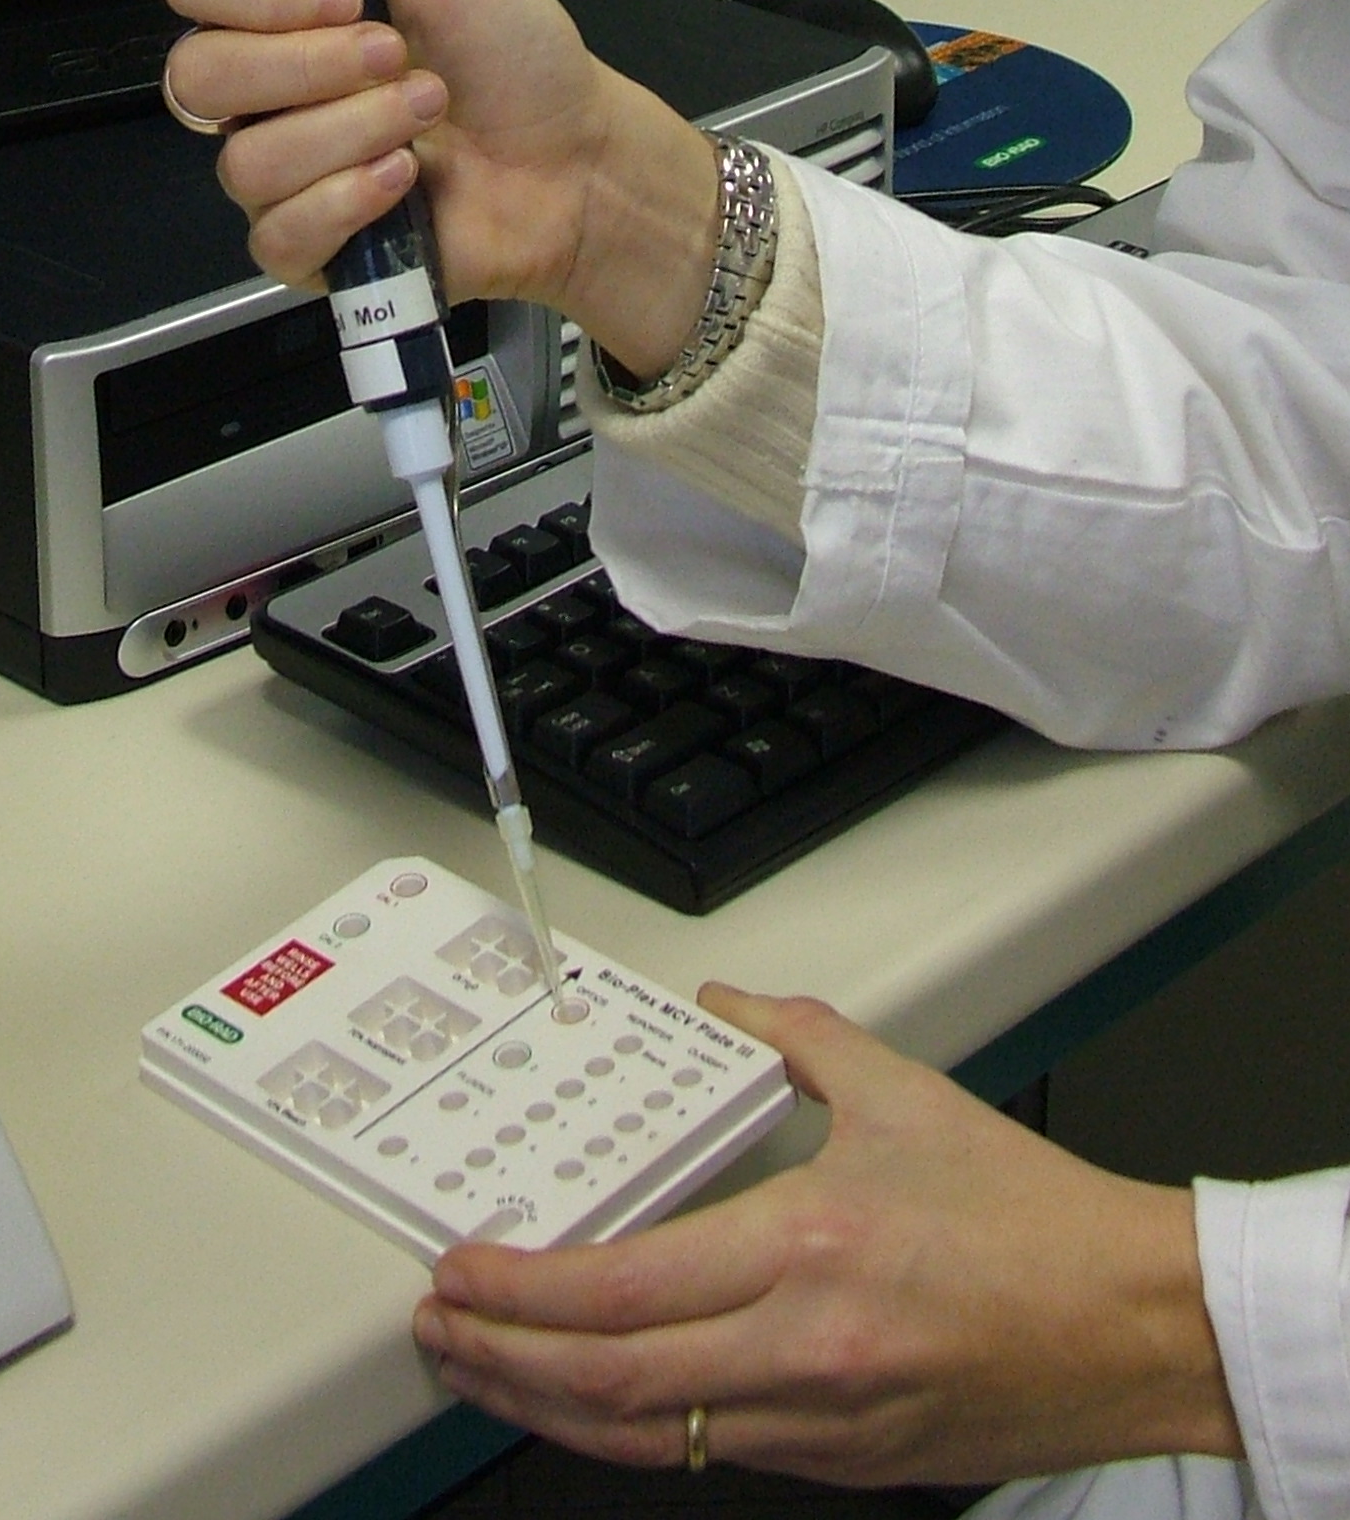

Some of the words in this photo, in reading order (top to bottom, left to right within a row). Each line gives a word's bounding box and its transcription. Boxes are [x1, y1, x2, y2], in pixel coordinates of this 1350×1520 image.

[354, 299, 396, 327] Mol
[596, 967, 657, 1008] Bio-Plex
[659, 1000, 692, 1027] MCV
[694, 1020, 735, 1049] Plate
